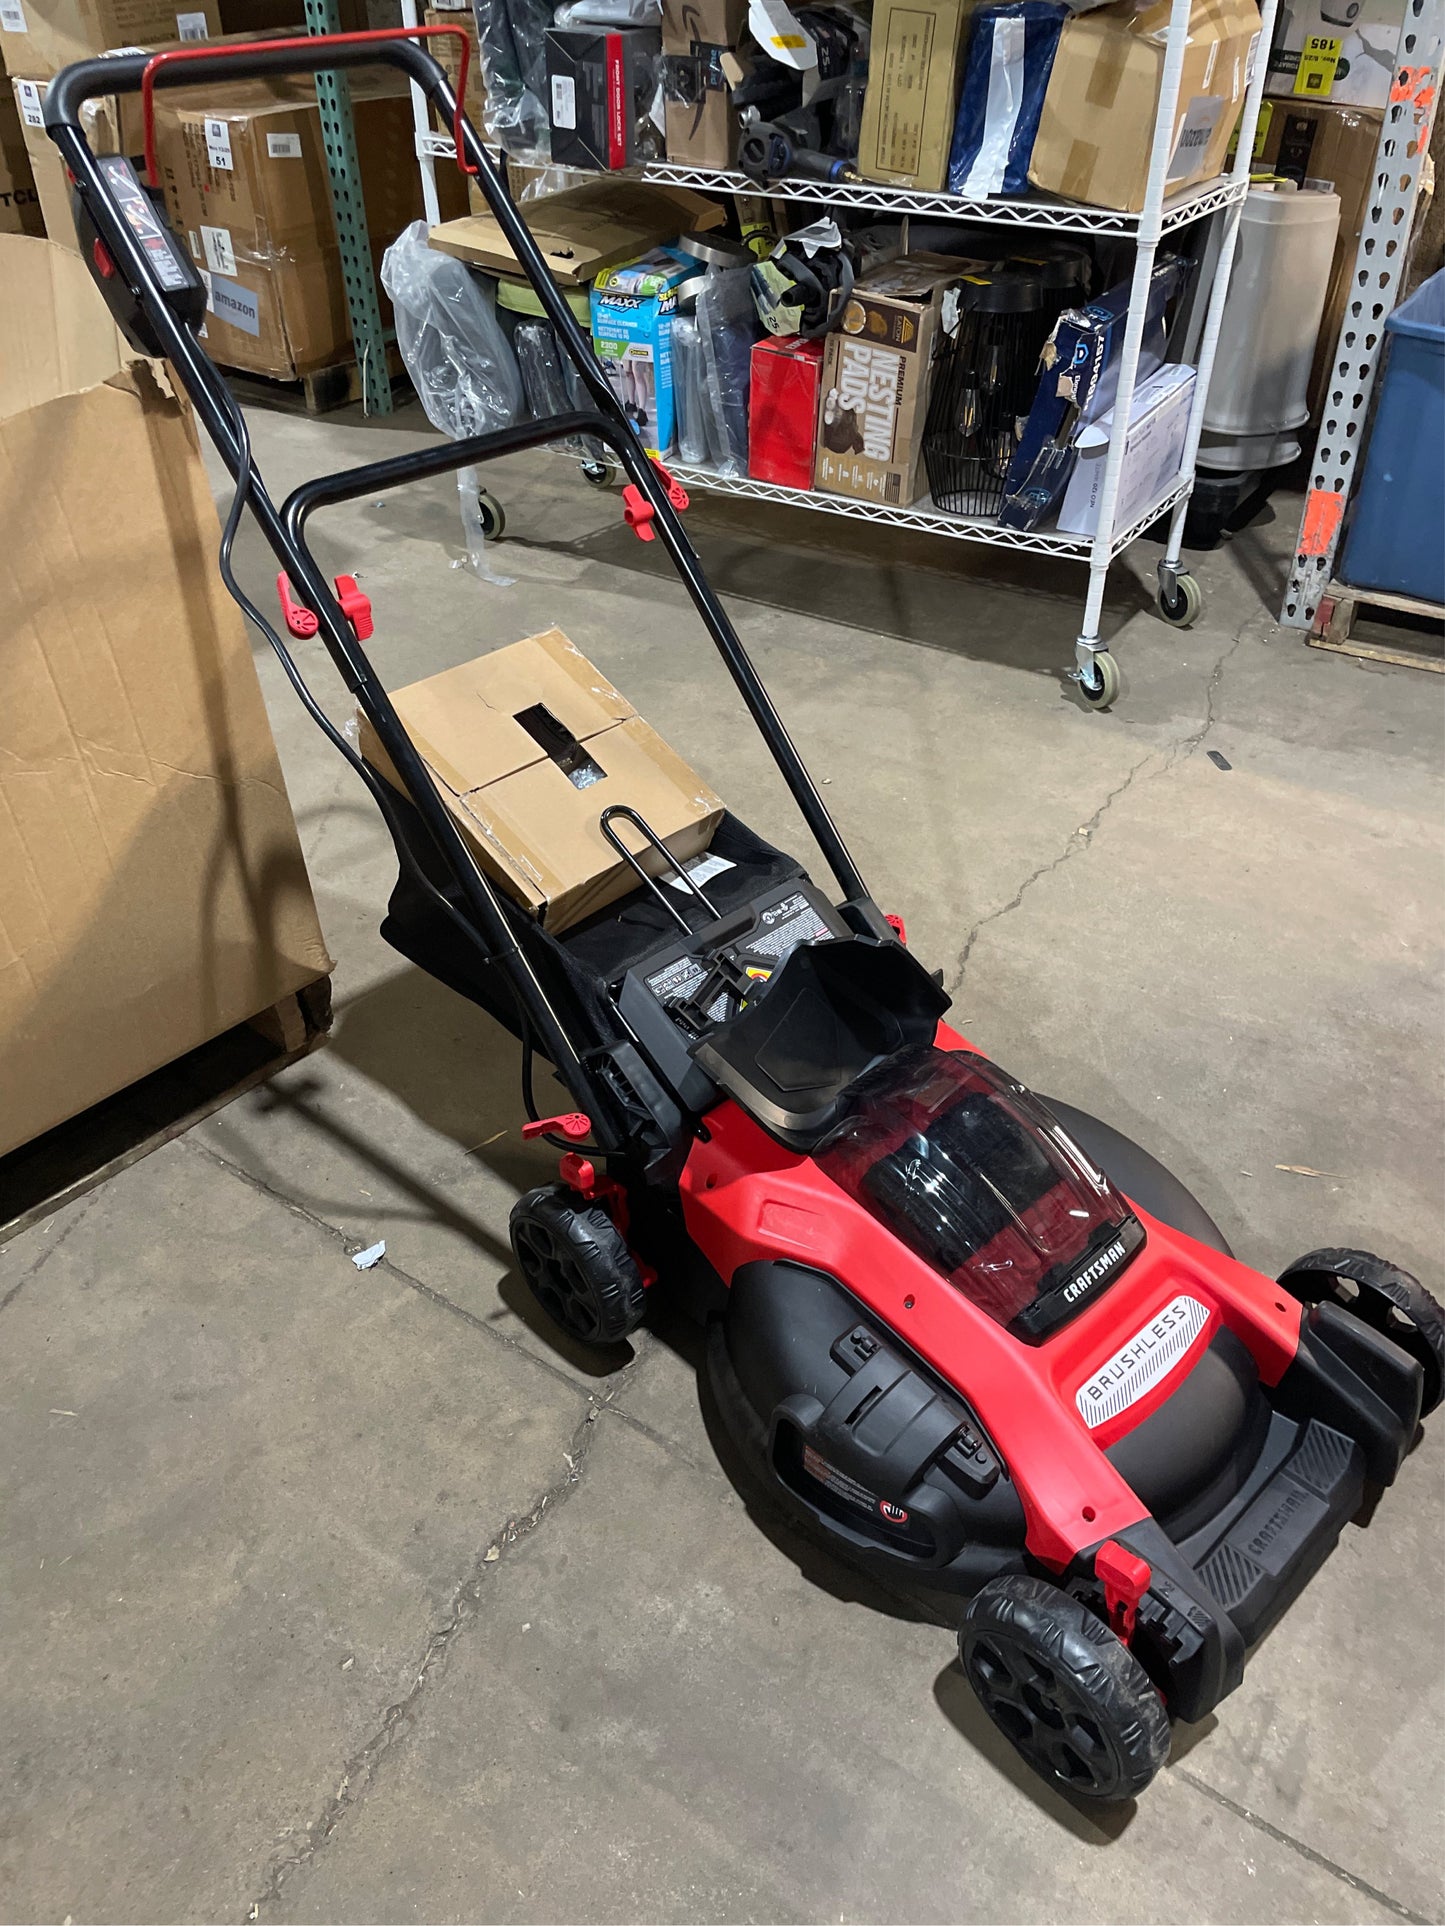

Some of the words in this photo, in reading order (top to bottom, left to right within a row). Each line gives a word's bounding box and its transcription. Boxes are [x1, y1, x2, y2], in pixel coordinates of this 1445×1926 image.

[1311, 38, 1335, 50] 185
[710, 49, 720, 85] prime
[216, 156, 226, 166] 51
[214, 290, 256, 319] amazon
[600, 296, 642, 308] MAXX
[768, 316, 780, 332] 25
[838, 342, 872, 414] PADS
[895, 355, 906, 405] PREMIUM
[863, 348, 899, 461] NESTING
[1089, 495, 1097, 508] NEO
[1062, 1241, 1126, 1303] CRAFTSMAN
[1086, 1304, 1186, 1401] BRUSHLESS
[1247, 1485, 1312, 1556] CRAFTSMAN
